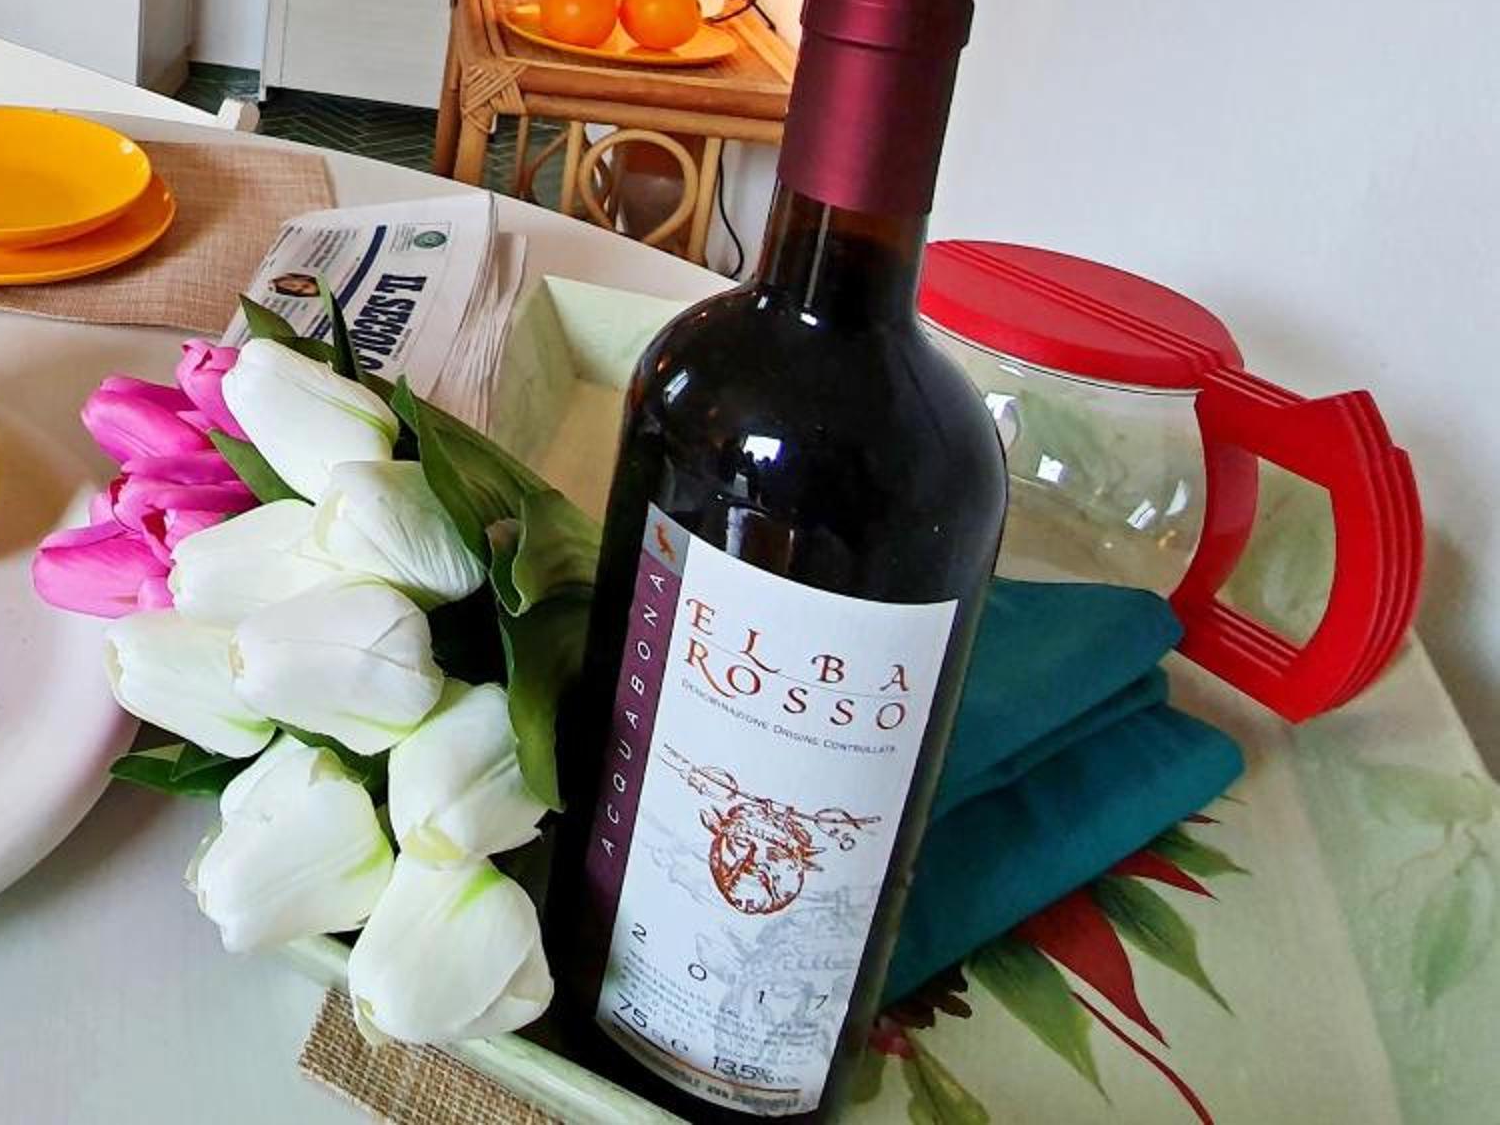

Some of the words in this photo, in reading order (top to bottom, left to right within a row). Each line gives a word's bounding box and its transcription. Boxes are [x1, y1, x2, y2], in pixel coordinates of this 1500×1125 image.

[375, 274, 428, 294] IL
[684, 637, 907, 731] ROSSO
[685, 598, 910, 693] ELBA
[600, 572, 667, 858] ACQUABONA
[617, 991, 649, 1028] 75
